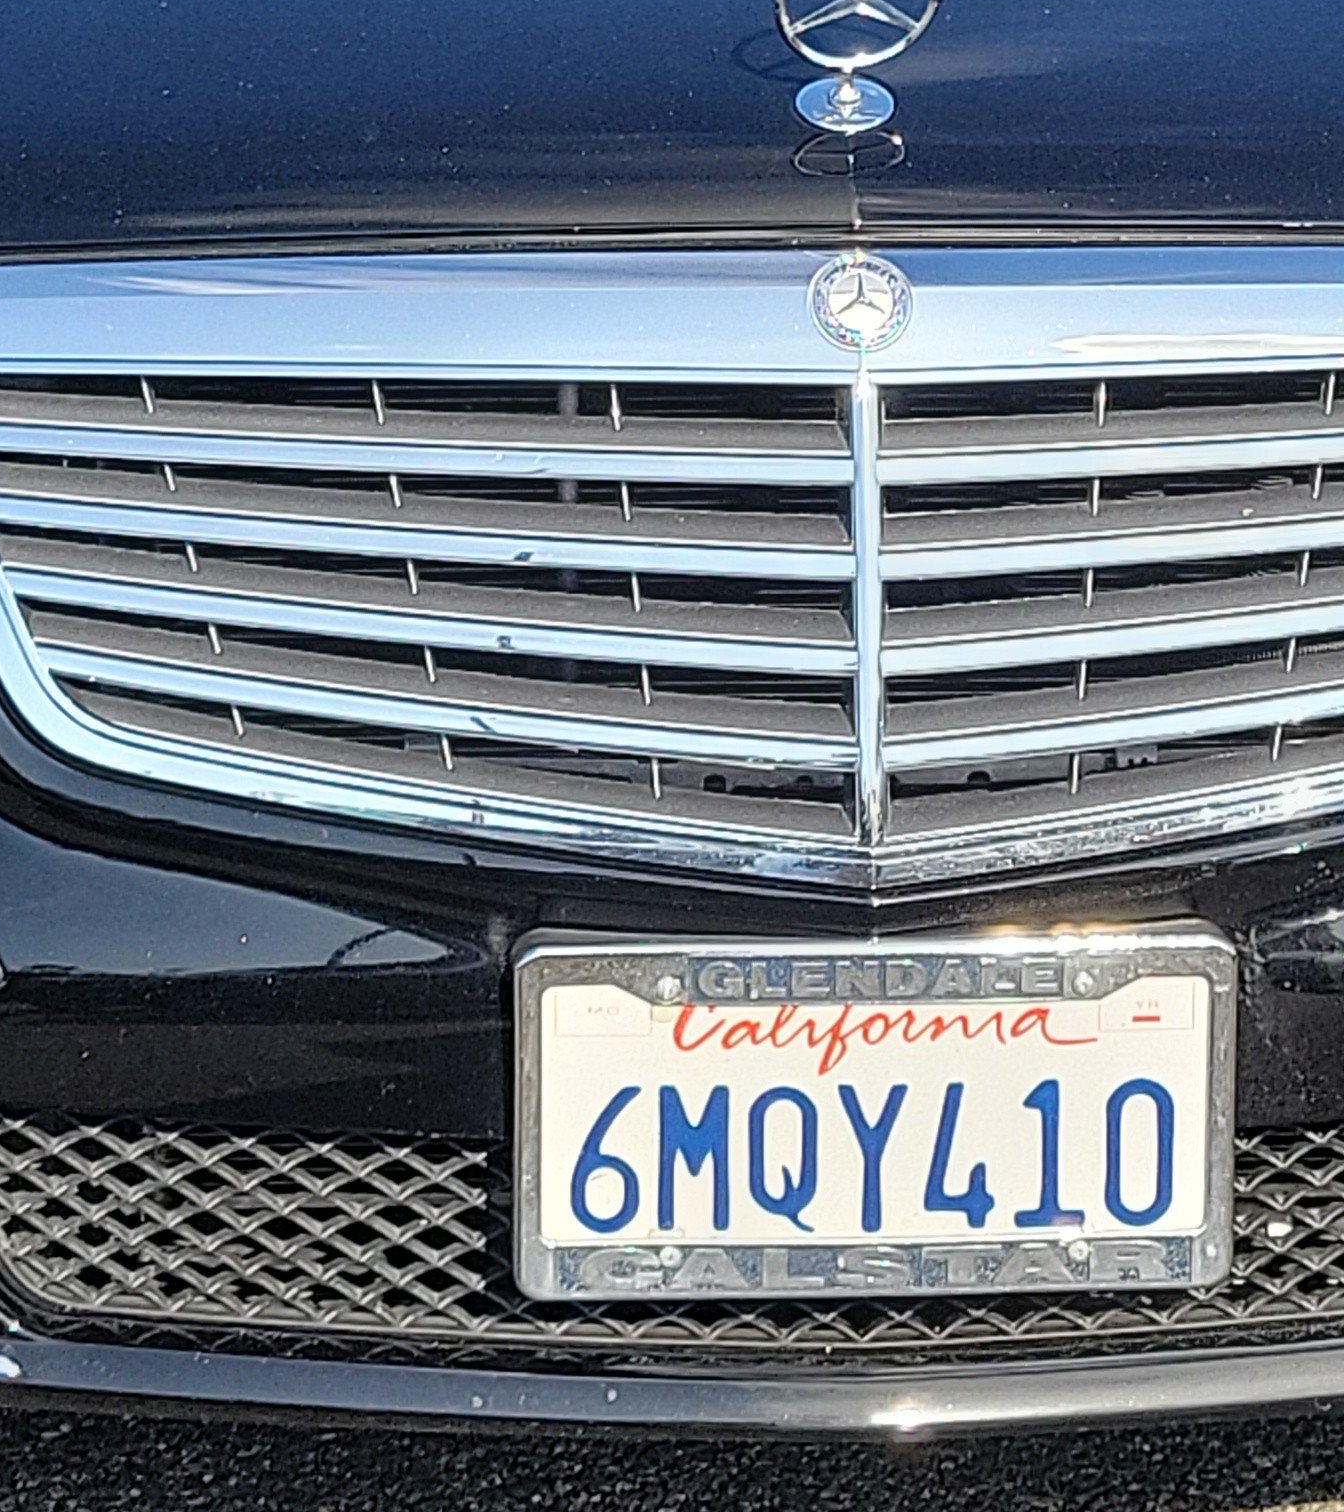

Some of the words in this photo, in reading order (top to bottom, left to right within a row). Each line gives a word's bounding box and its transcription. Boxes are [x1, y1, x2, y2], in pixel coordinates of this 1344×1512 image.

[697, 958, 1062, 999] GLENDALE
[671, 1001, 1099, 1076] California
[569, 1077, 1175, 1234] 6MQY410
[580, 1244, 1170, 1289] CALSTAR
